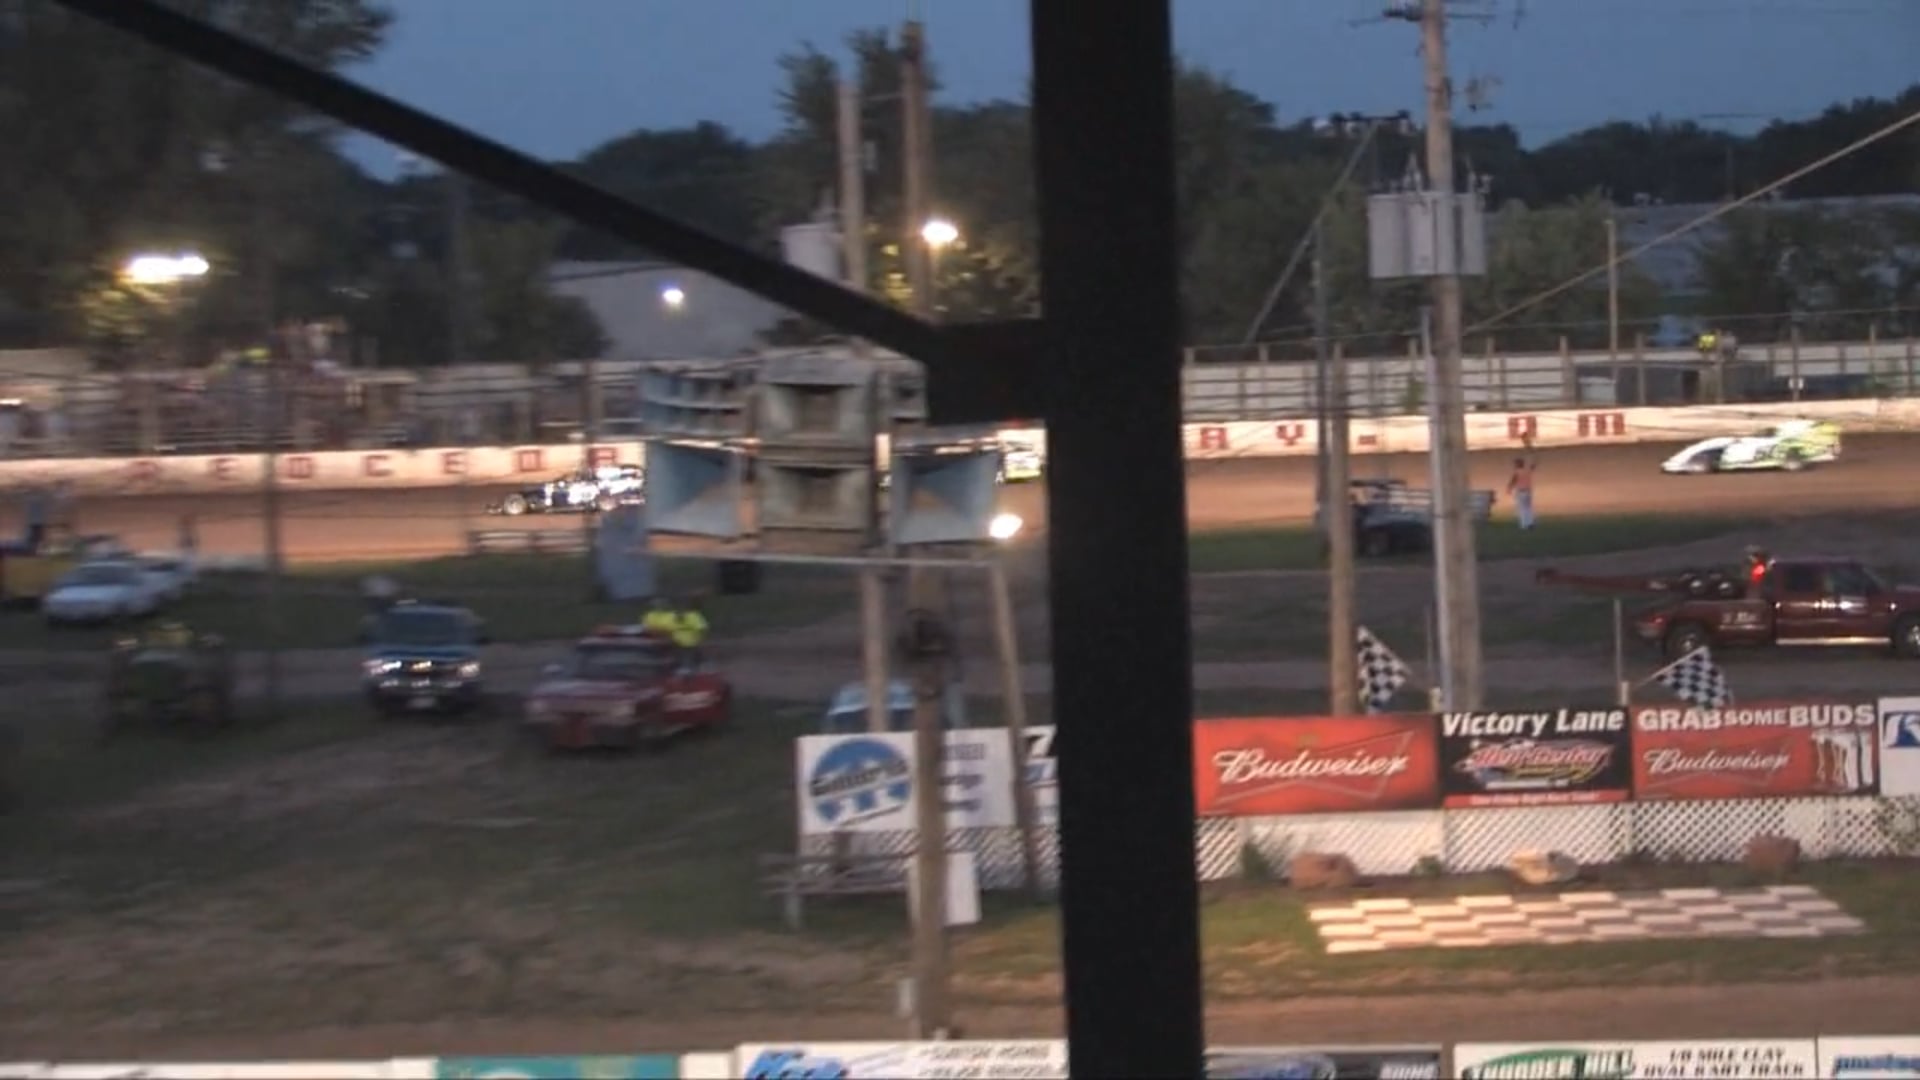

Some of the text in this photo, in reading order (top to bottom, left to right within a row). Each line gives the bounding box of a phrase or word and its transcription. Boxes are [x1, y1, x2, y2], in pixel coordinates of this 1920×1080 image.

[1442, 707, 1625, 736] Victory Lane
[1637, 704, 1876, 731] GRAB SOME BUDS
[1212, 748, 1410, 784] Budweiser
[1643, 748, 1791, 775] Budweiser
